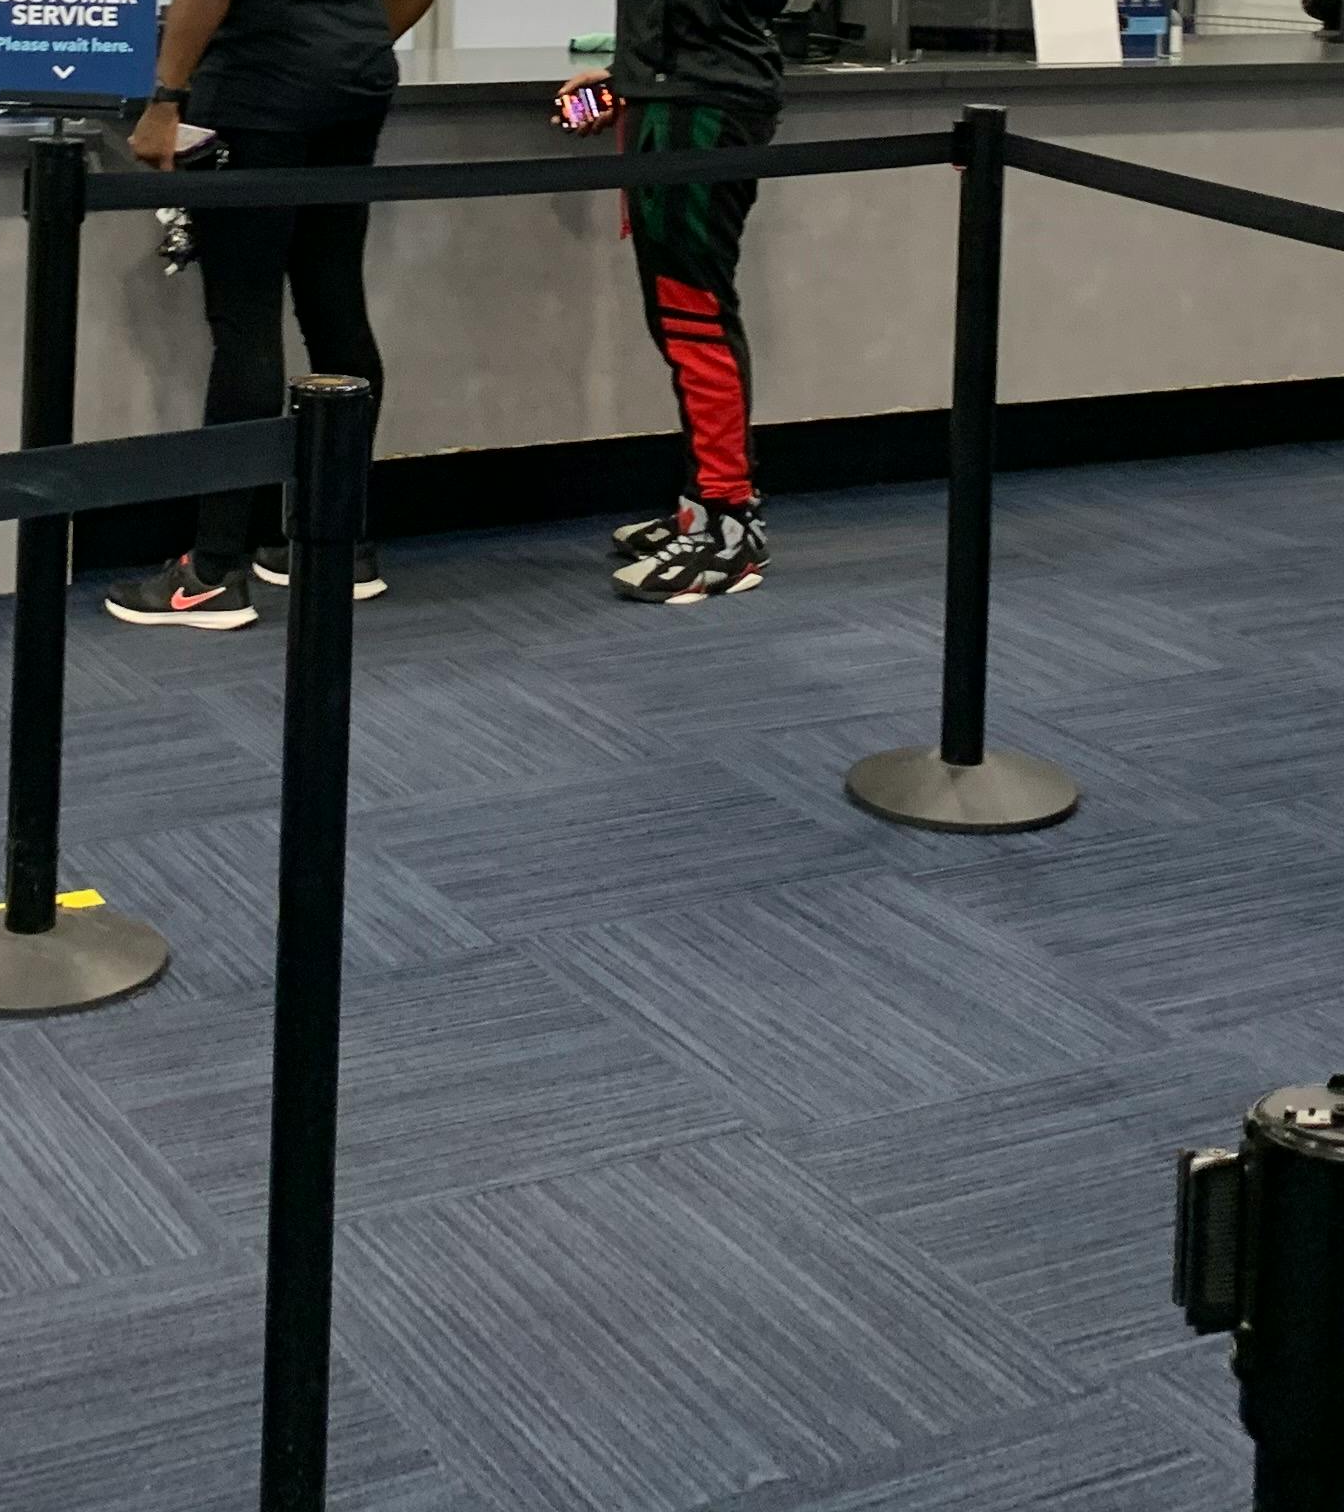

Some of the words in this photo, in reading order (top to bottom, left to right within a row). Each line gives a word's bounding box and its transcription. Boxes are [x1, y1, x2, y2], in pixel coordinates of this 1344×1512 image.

[11, 4, 119, 27] SERVICE
[52, 37, 89, 53] wait
[91, 37, 135, 54] here.
